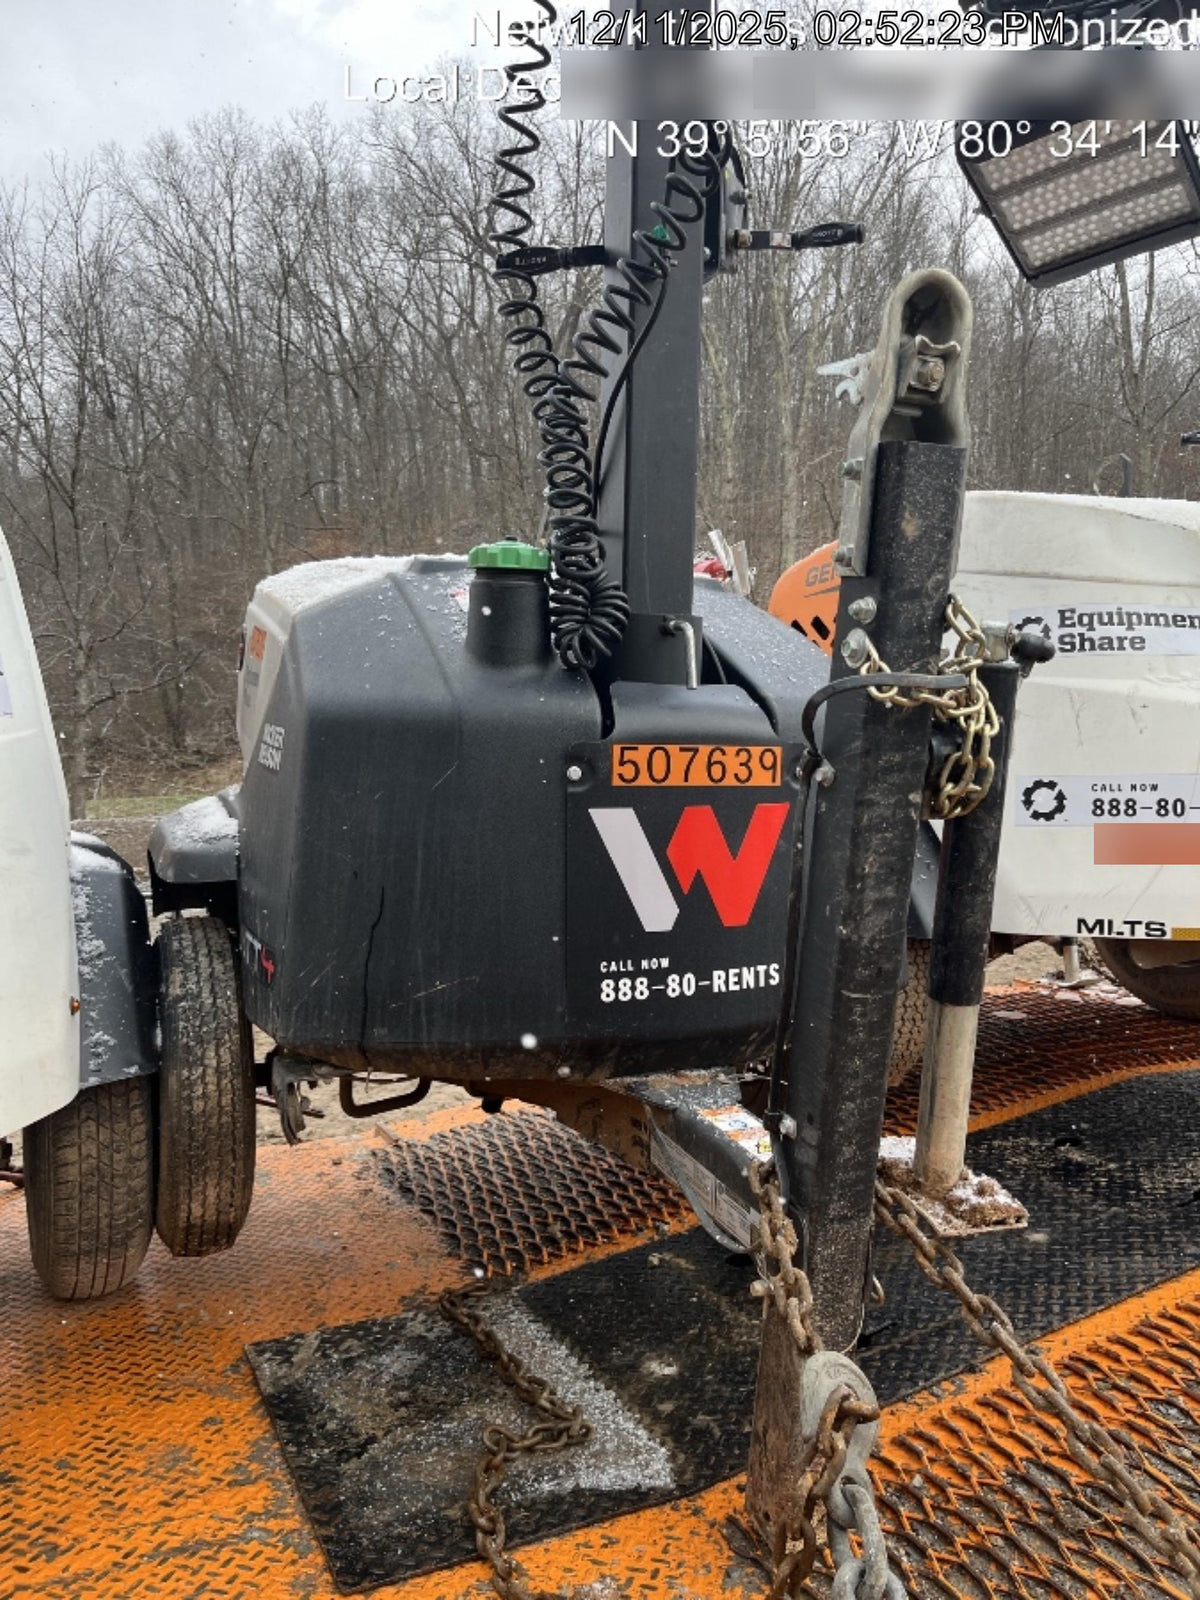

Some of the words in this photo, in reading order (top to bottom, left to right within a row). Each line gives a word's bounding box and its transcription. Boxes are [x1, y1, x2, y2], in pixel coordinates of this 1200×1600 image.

[1057, 633, 1146, 653] Share
[617, 746, 778, 784] 507639
[1091, 783, 1123, 792] CALL
[1130, 783, 1159, 792] NOW
[600, 959, 634, 973] CALL
[641, 957, 670, 970] NOW
[600, 963, 780, 1003] 888-80-RENTS
